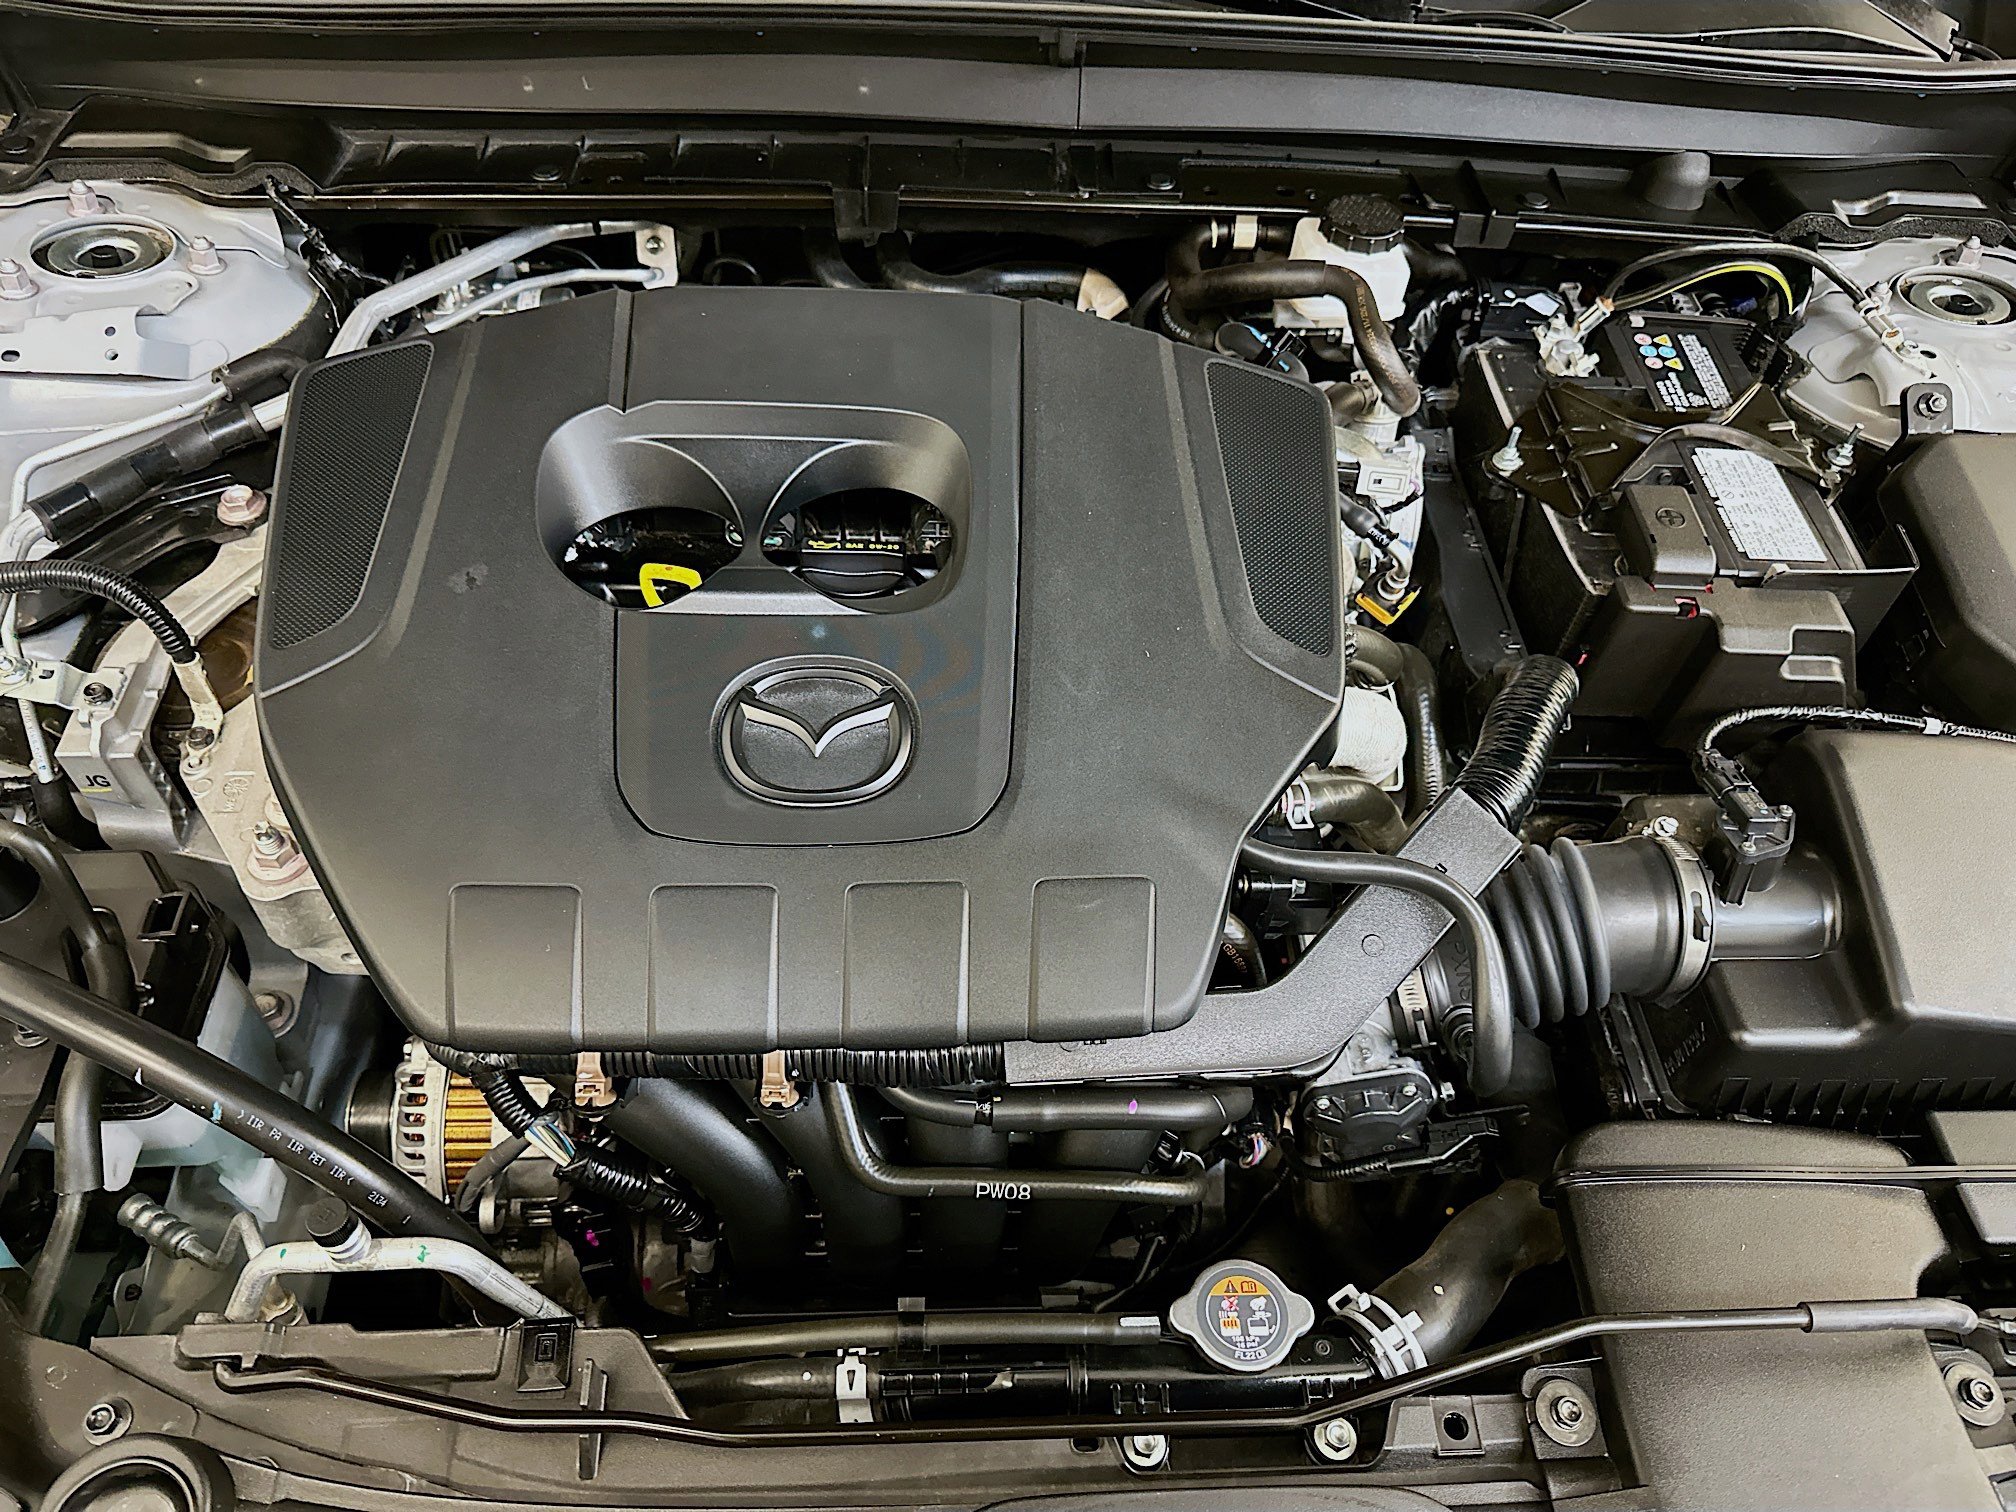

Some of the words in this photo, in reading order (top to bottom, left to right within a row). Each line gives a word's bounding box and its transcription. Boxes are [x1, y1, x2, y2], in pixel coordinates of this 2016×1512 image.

[85, 774, 112, 788] JG
[308, 1151, 327, 1167] PET
[976, 1182, 1031, 1200] PW08
